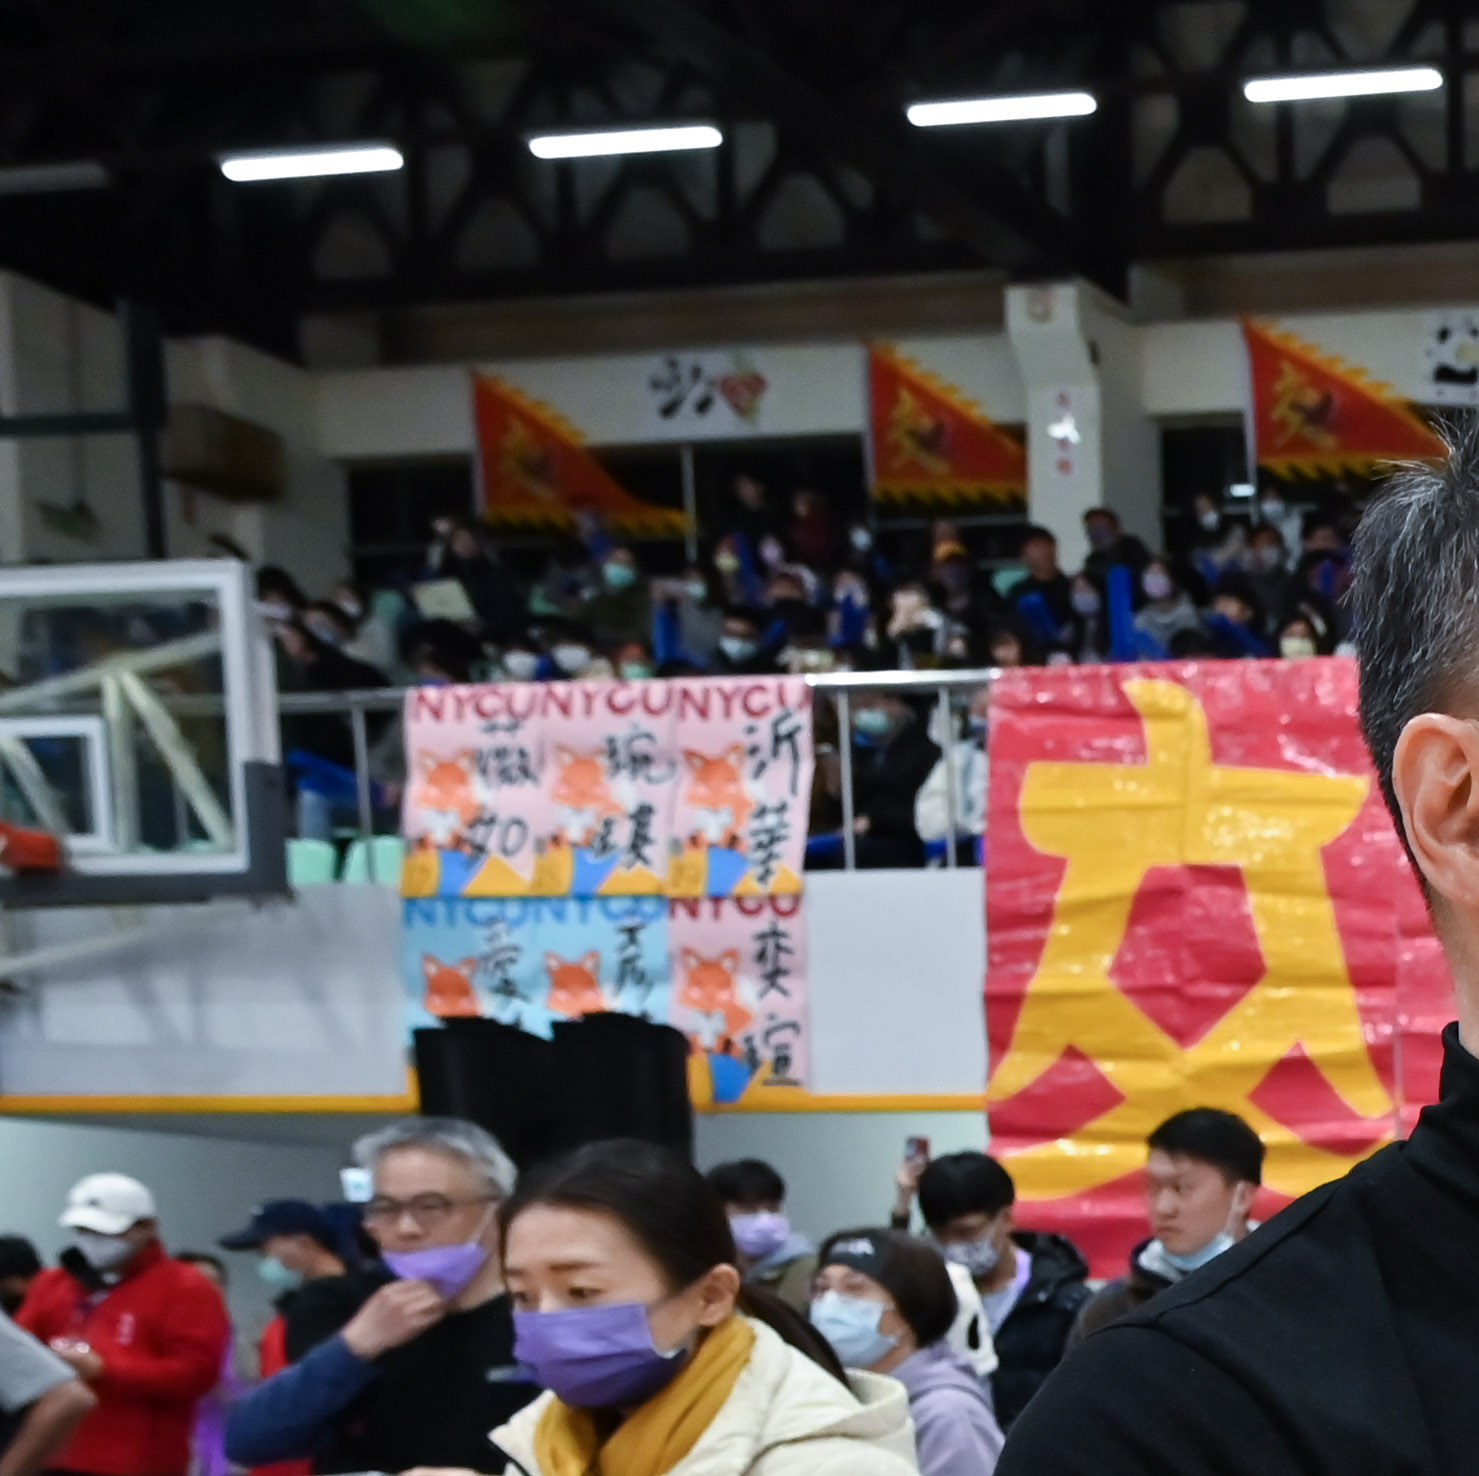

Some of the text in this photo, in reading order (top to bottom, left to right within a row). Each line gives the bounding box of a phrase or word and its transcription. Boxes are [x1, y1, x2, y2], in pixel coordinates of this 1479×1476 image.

[414, 682, 812, 723] NYCU NYCU NYCU
[987, 678, 1402, 1200] 交
